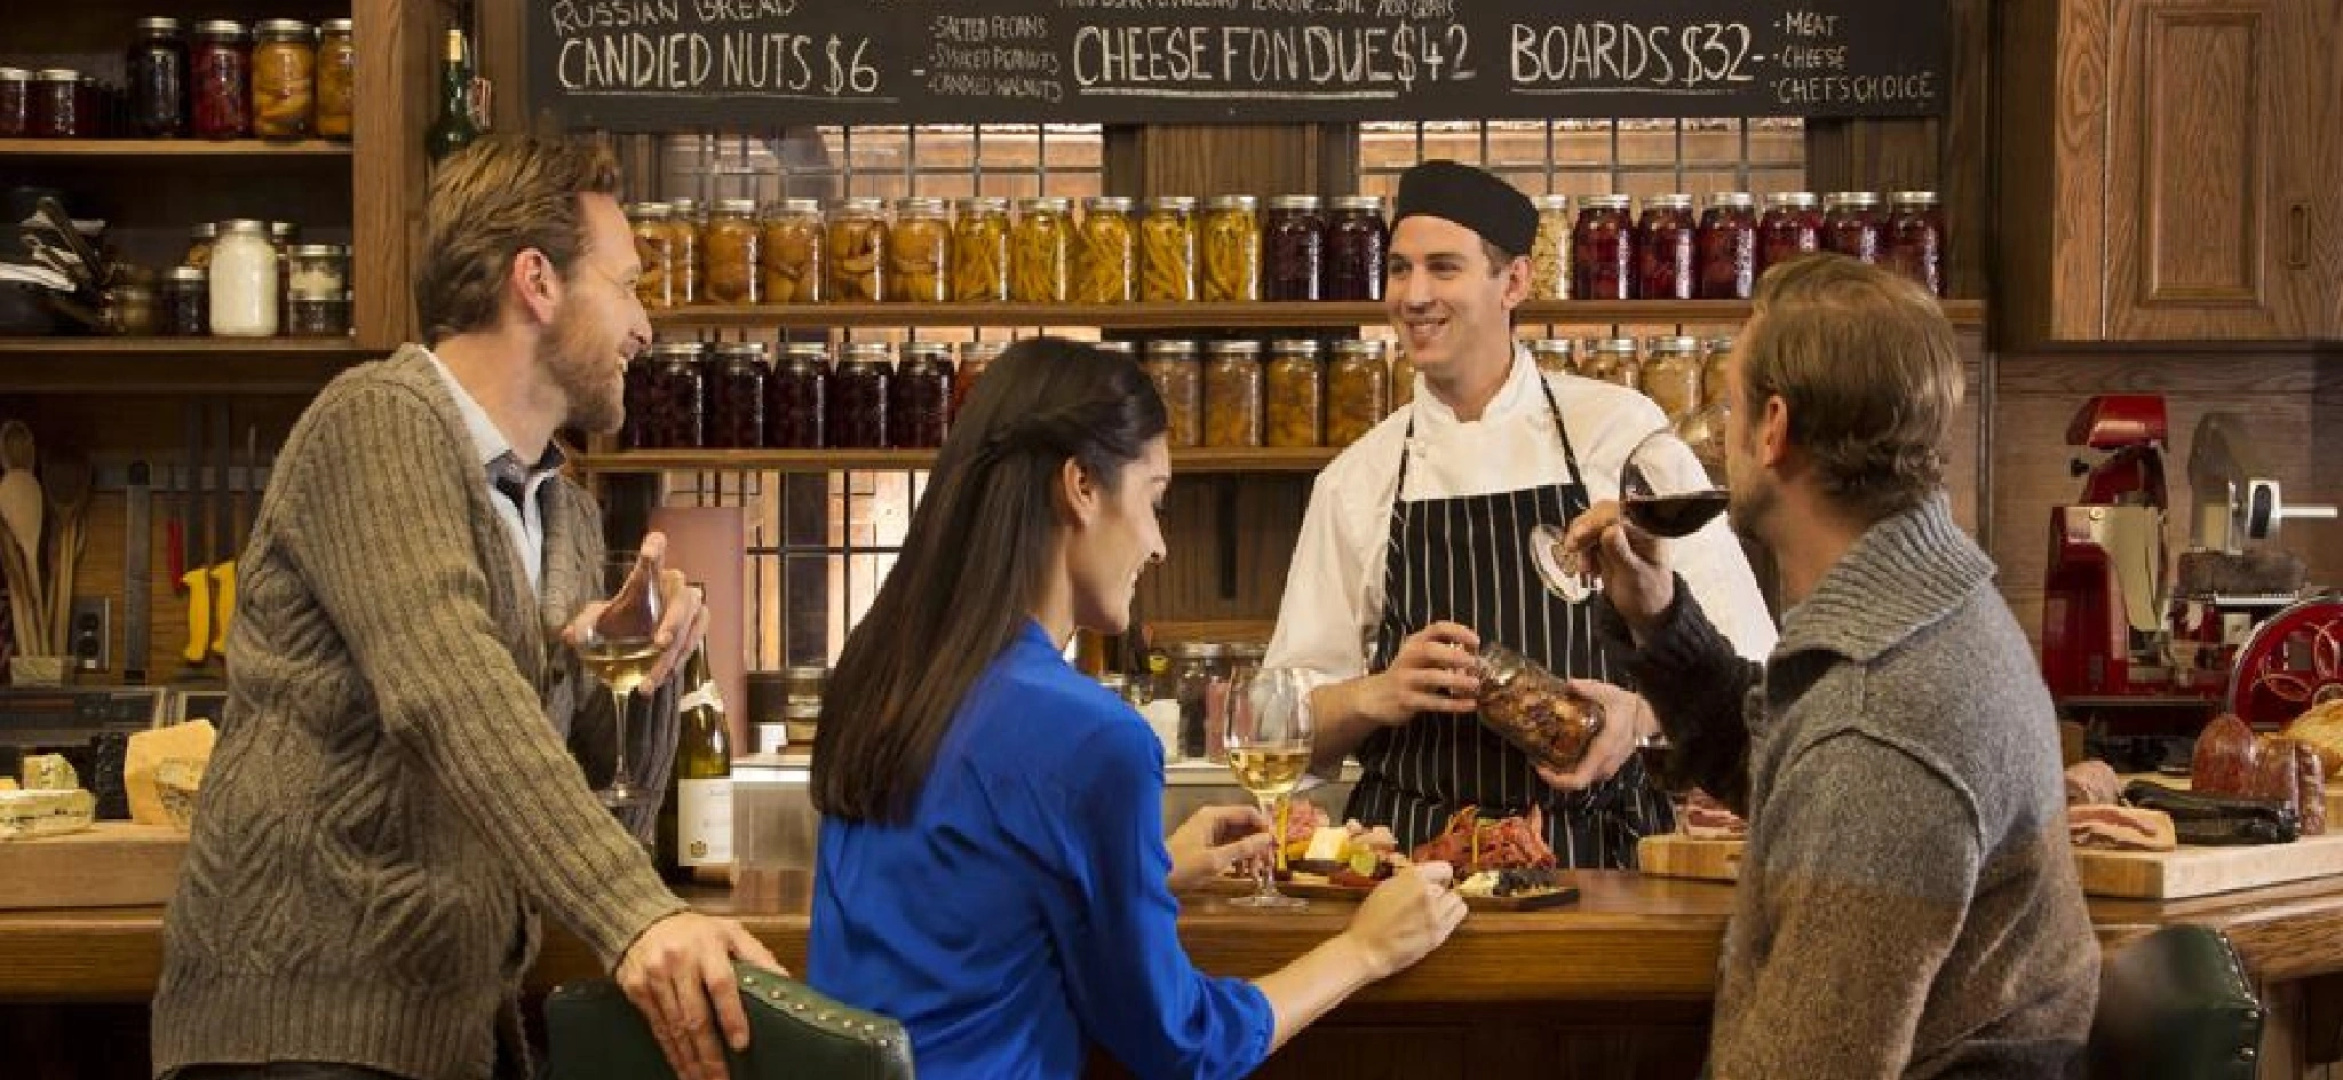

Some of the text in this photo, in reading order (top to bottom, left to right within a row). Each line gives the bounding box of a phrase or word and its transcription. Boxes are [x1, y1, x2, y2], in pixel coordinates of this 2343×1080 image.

[551, 0, 679, 34] RUSSIAN
[558, 30, 878, 95] CANDIED NUTS $6
[1073, 26, 1213, 86] CHEESE
[1511, 21, 1674, 84] BOARDS
